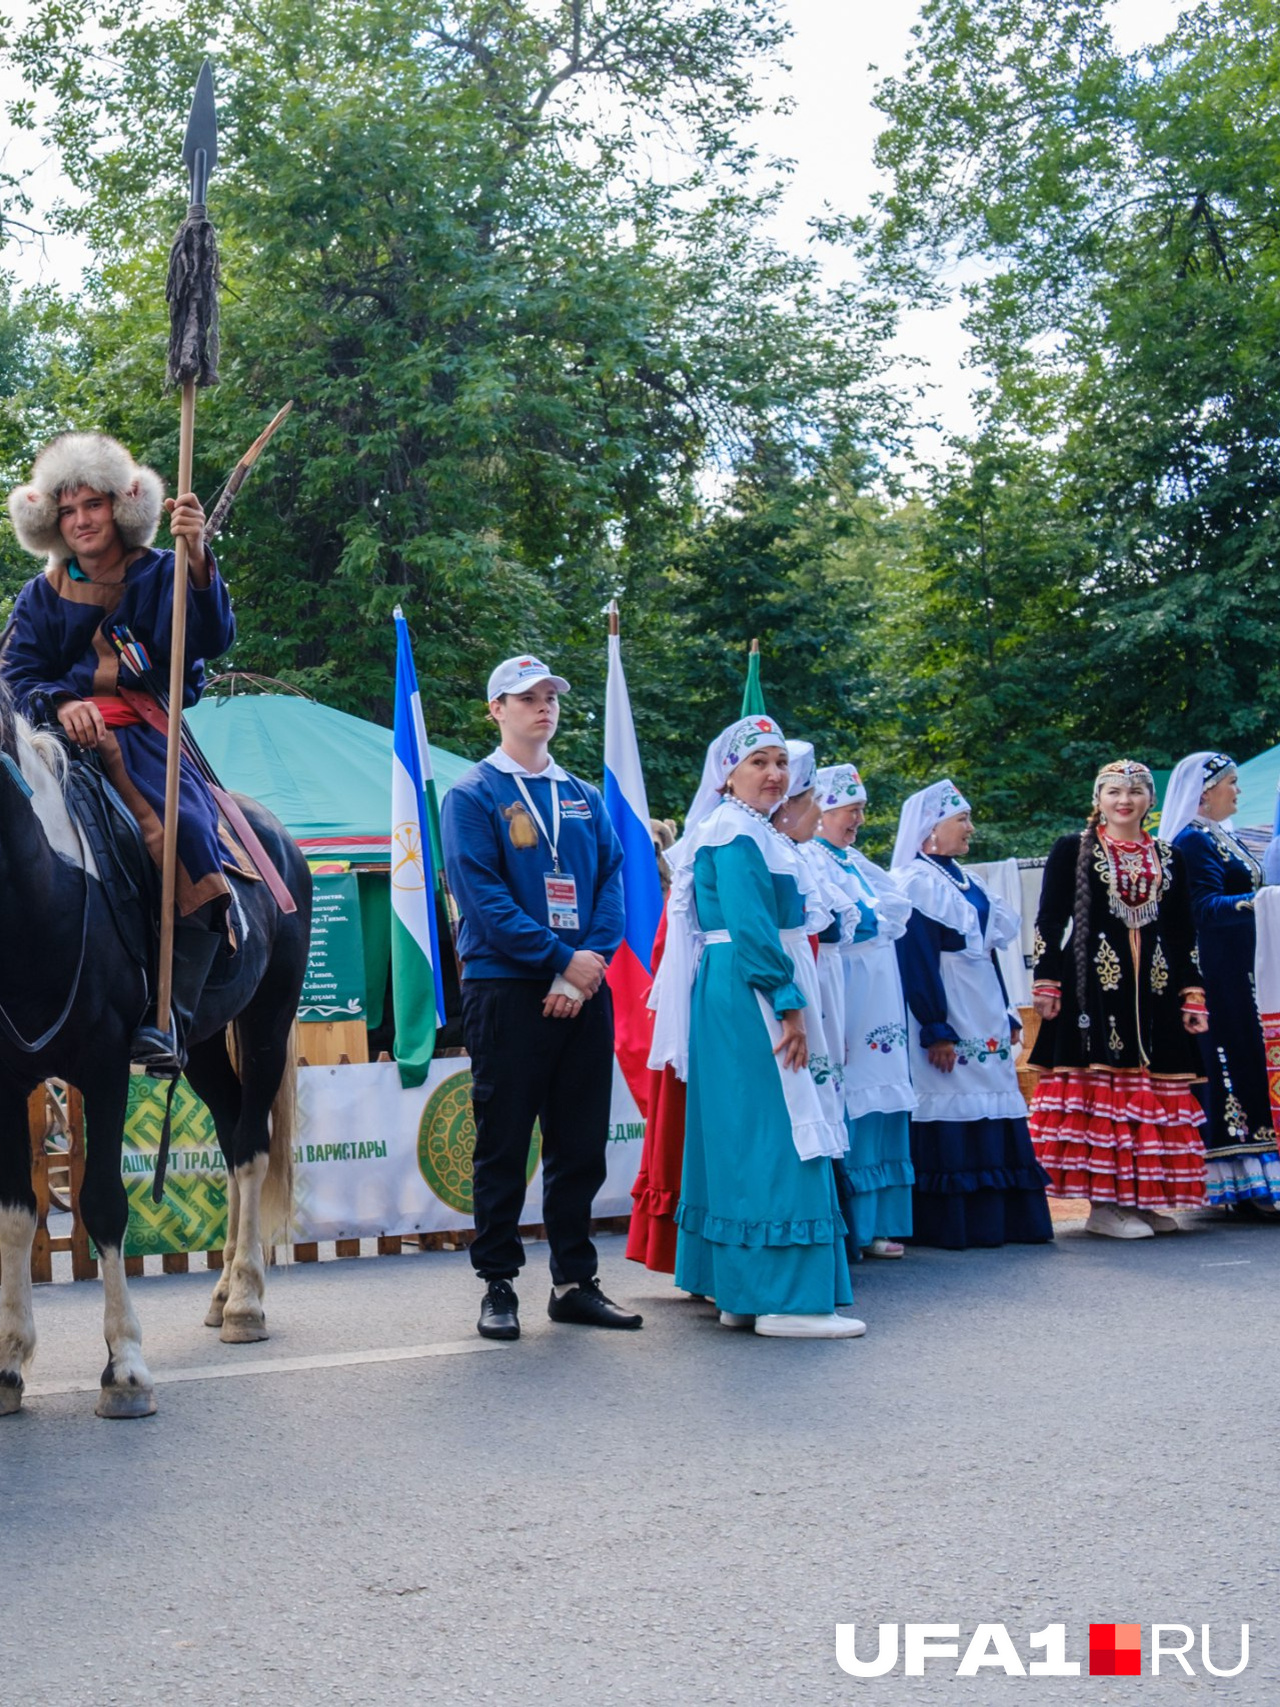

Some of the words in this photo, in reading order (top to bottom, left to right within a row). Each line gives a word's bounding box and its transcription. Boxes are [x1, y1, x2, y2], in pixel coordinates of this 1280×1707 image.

[608, 1122, 647, 1145] ЕДНИ
[183, 1150, 226, 1172] ТРАД
[306, 1139, 388, 1163] ВАРИСТАРЫ
